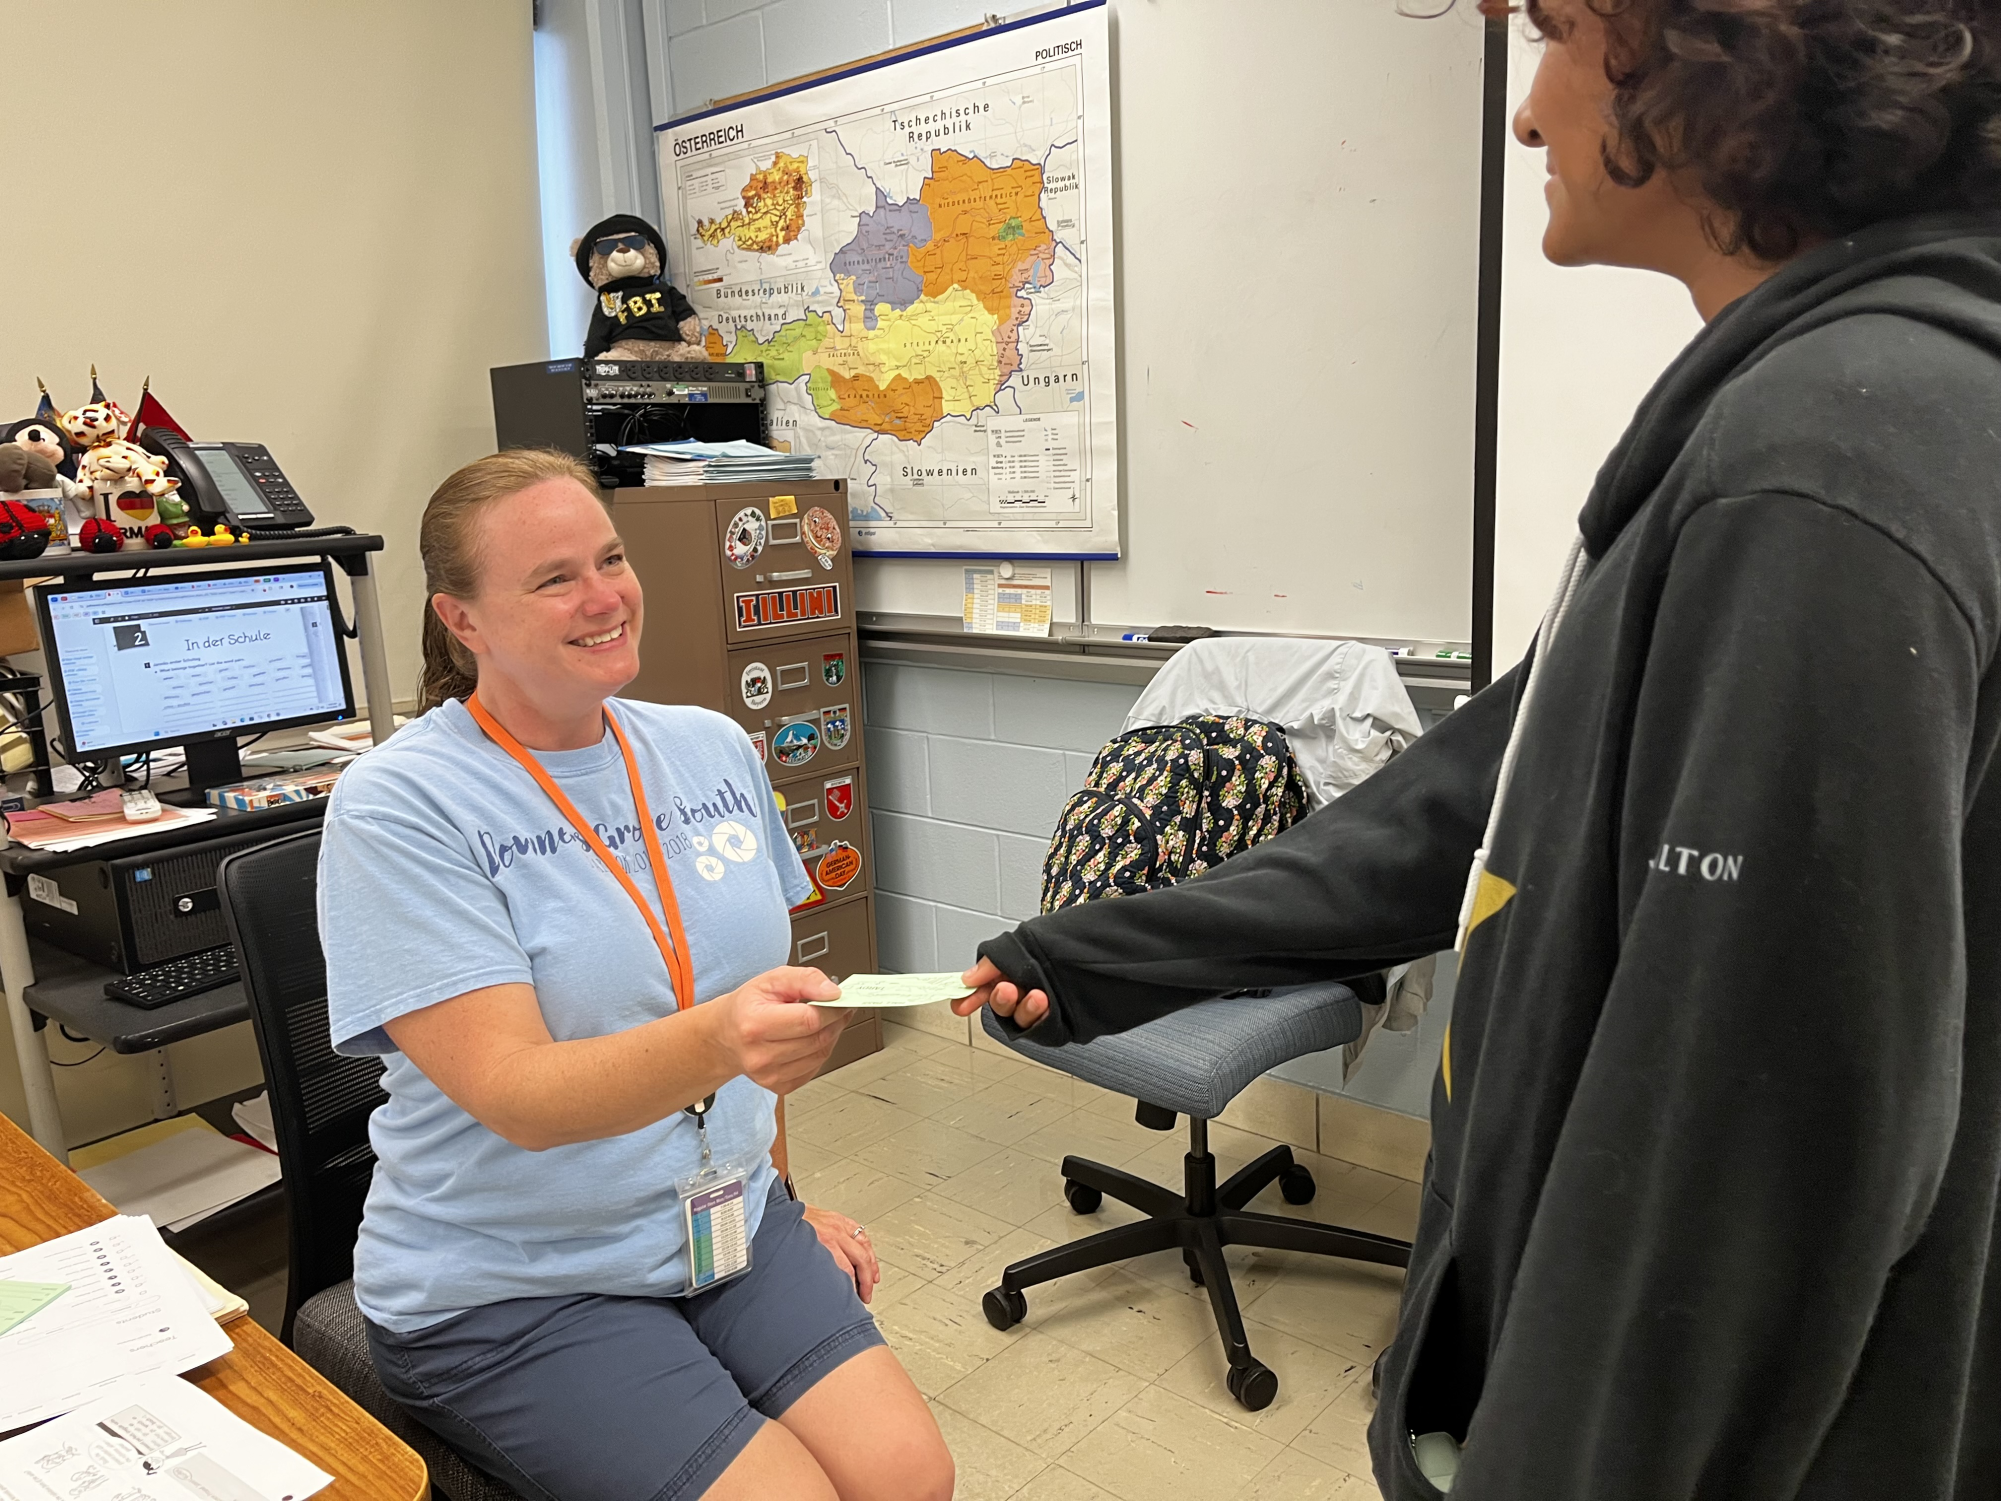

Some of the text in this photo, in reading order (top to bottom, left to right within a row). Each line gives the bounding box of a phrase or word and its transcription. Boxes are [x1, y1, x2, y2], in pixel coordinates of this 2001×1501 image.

[1034, 39, 1083, 62] POLITISCH
[891, 101, 990, 132] Tschechische
[673, 123, 745, 157] ÖSTERREICH
[908, 119, 972, 143] Republik
[1043, 180, 1080, 195] Republik
[1046, 173, 1076, 185] Slowak
[715, 281, 806, 299] Bundesrepublik
[616, 291, 665, 325] FBI
[717, 310, 788, 325] Deutschland
[903, 337, 969, 348] STEIERMARK
[827, 351, 861, 359] SALZBURG
[1021, 371, 1079, 387] Ungarn
[769, 417, 798, 428] alien
[902, 465, 978, 478] Slowenien
[759, 587, 835, 624] ILLINI
[133, 632, 146, 646] 2
[184, 629, 272, 651] In der Schule
[214, 729, 232, 738] acer
[592, 810, 673, 851] Groe
[673, 778, 758, 826] South
[663, 832, 693, 860] 2018
[130, 1335, 178, 1353] Teachers
